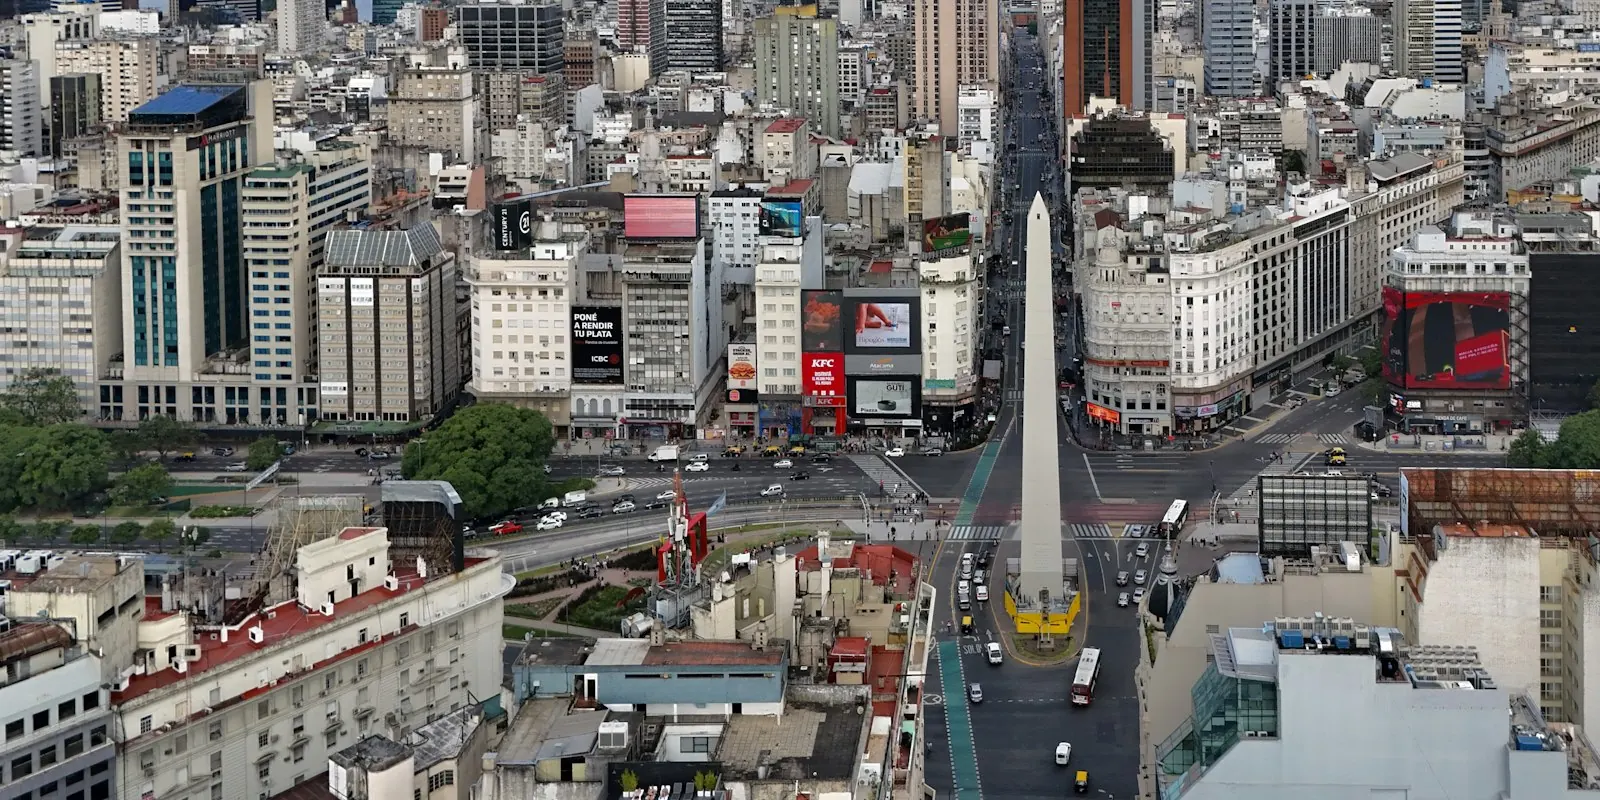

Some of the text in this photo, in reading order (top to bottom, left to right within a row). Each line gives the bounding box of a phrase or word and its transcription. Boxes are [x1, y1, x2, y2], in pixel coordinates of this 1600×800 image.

[208, 129, 236, 141] MARRIOTT
[522, 216, 529, 228] 21
[574, 312, 597, 321] PONÉ
[811, 359, 834, 368] KFC
